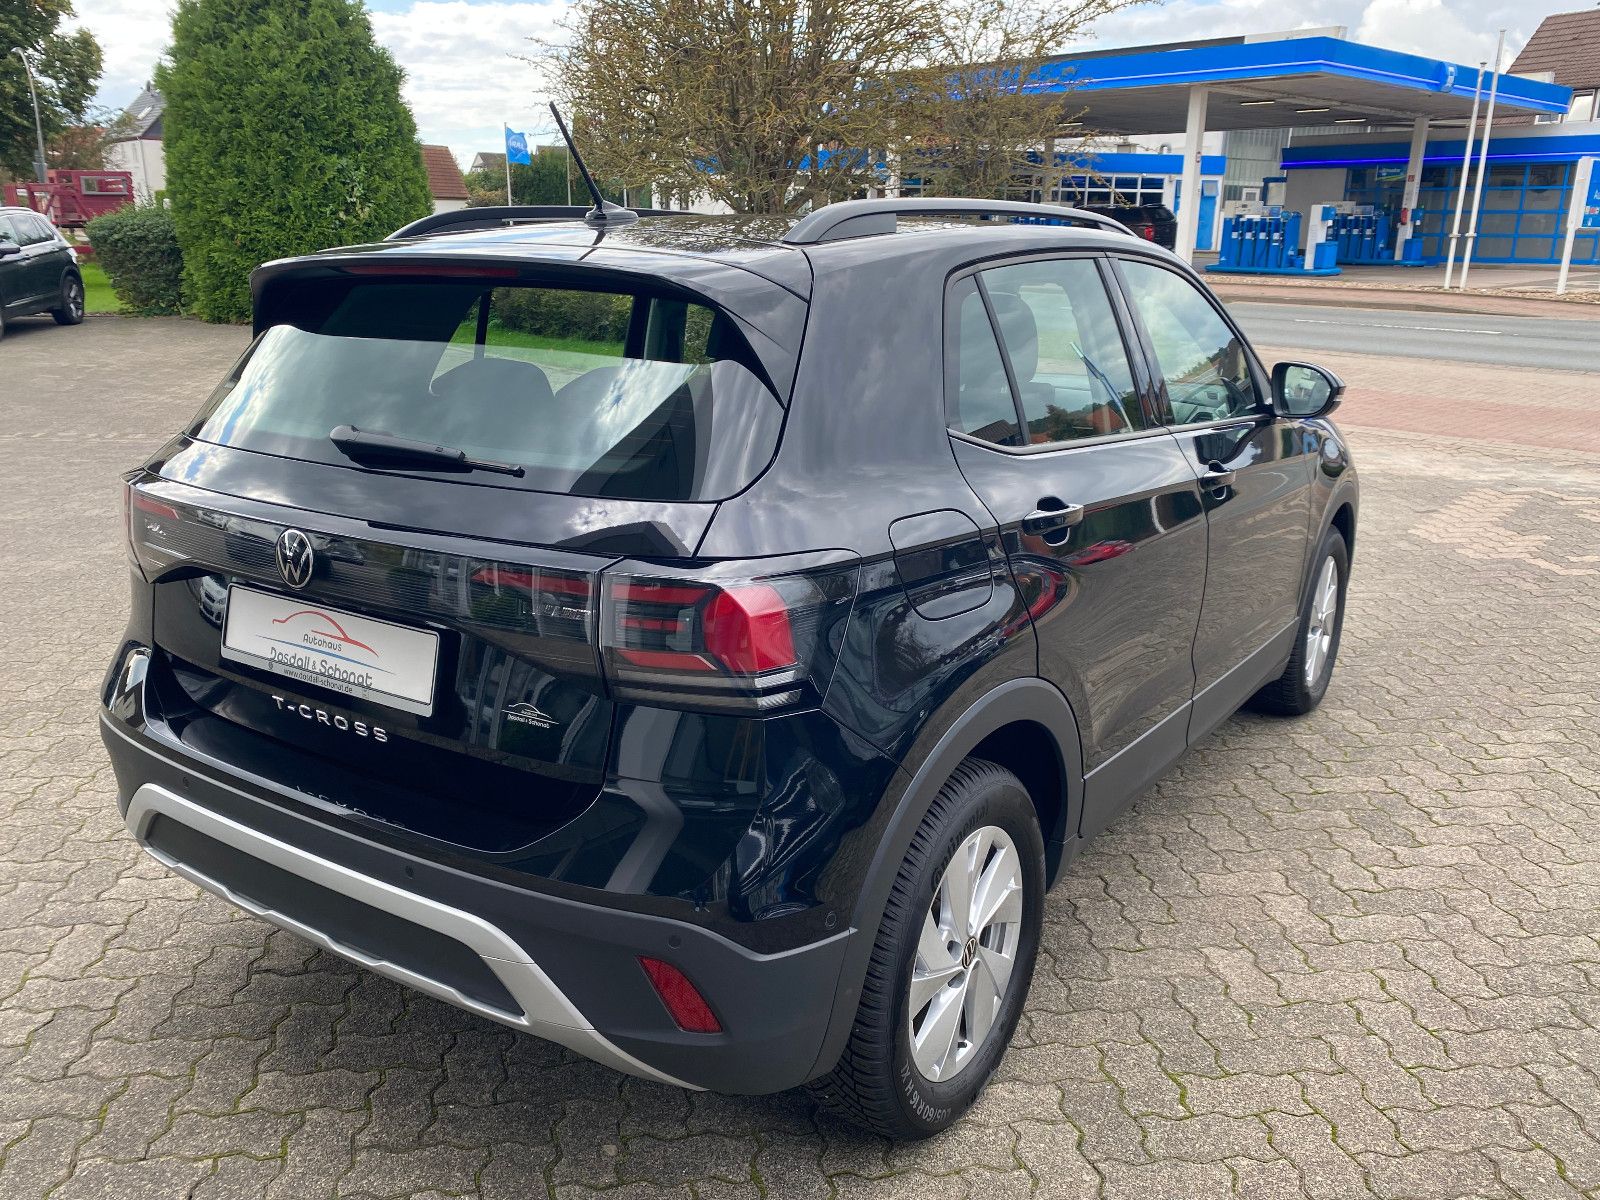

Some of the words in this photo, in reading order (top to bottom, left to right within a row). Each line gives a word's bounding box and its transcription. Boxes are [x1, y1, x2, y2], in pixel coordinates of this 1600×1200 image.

[303, 634, 342, 651] Autohaus
[270, 647, 311, 670] Dosdall
[312, 660, 317, 670] &
[319, 659, 373, 687] Schonat
[272, 695, 388, 742] T-CROSS
